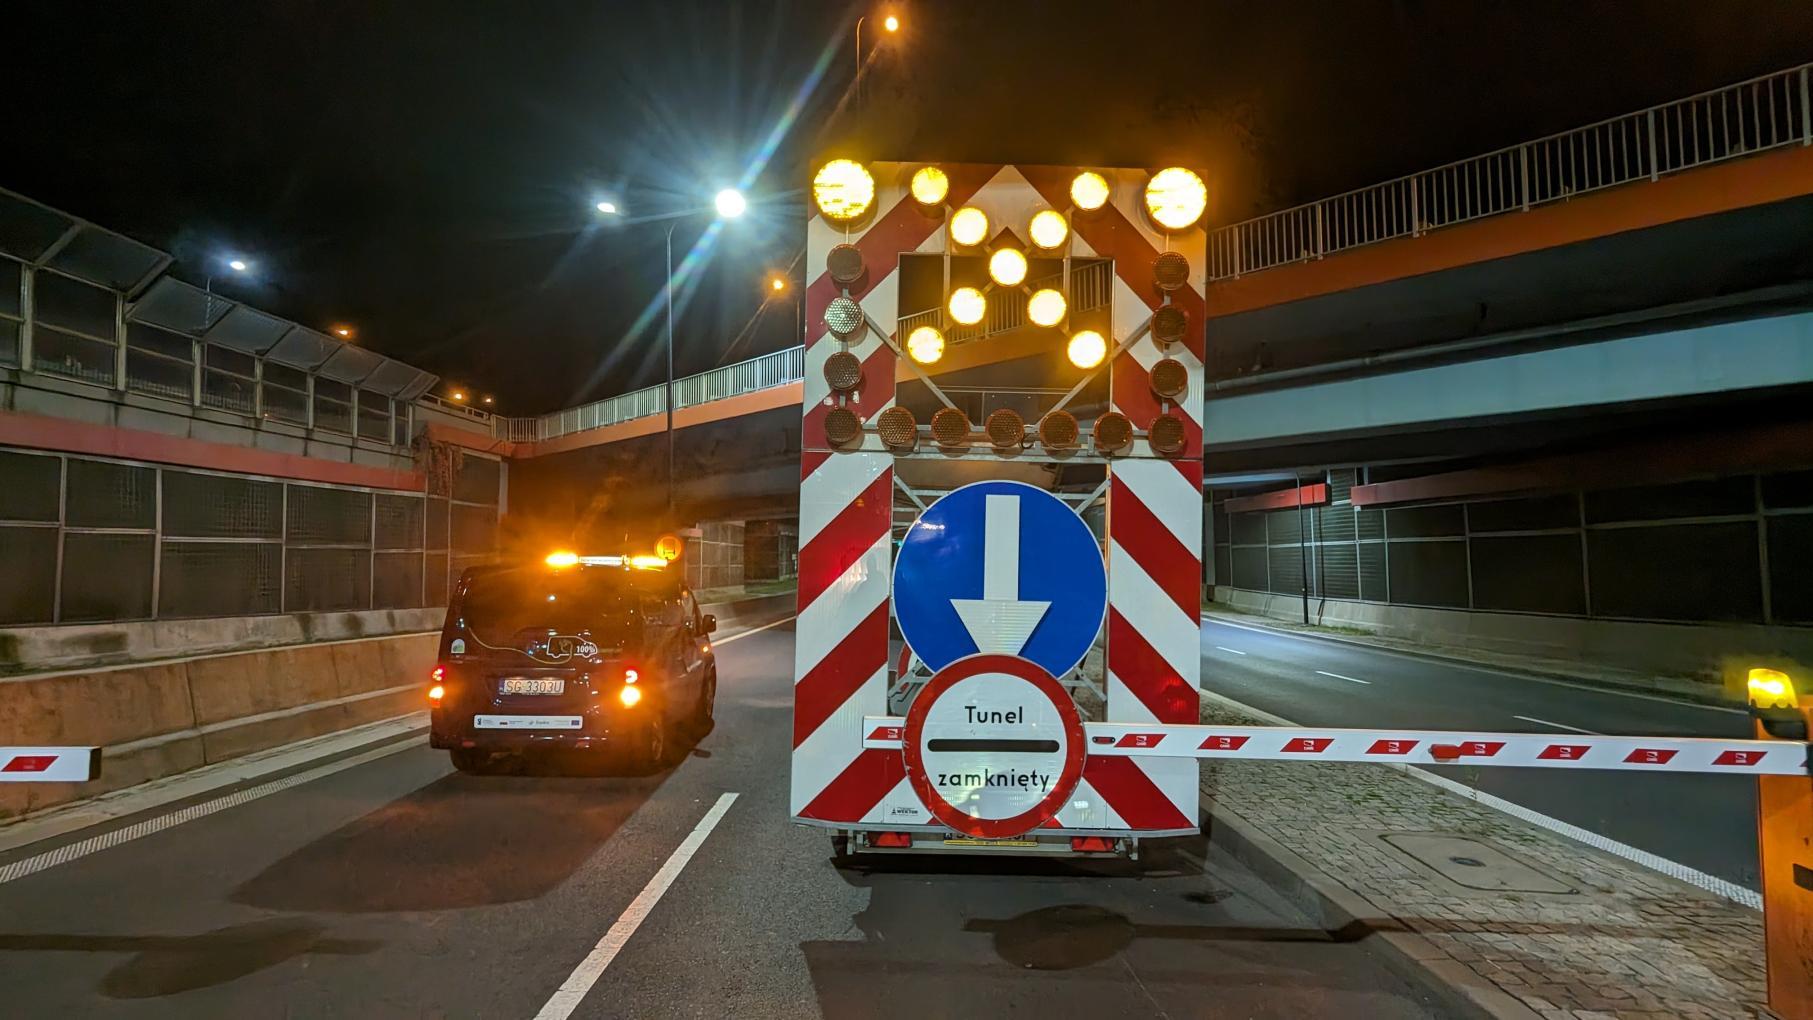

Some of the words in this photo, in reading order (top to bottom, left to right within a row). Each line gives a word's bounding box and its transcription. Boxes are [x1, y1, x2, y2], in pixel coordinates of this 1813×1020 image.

[506, 681, 521, 692] SG
[964, 705, 1023, 724] Tunel
[938, 768, 1050, 792] zamknięty
